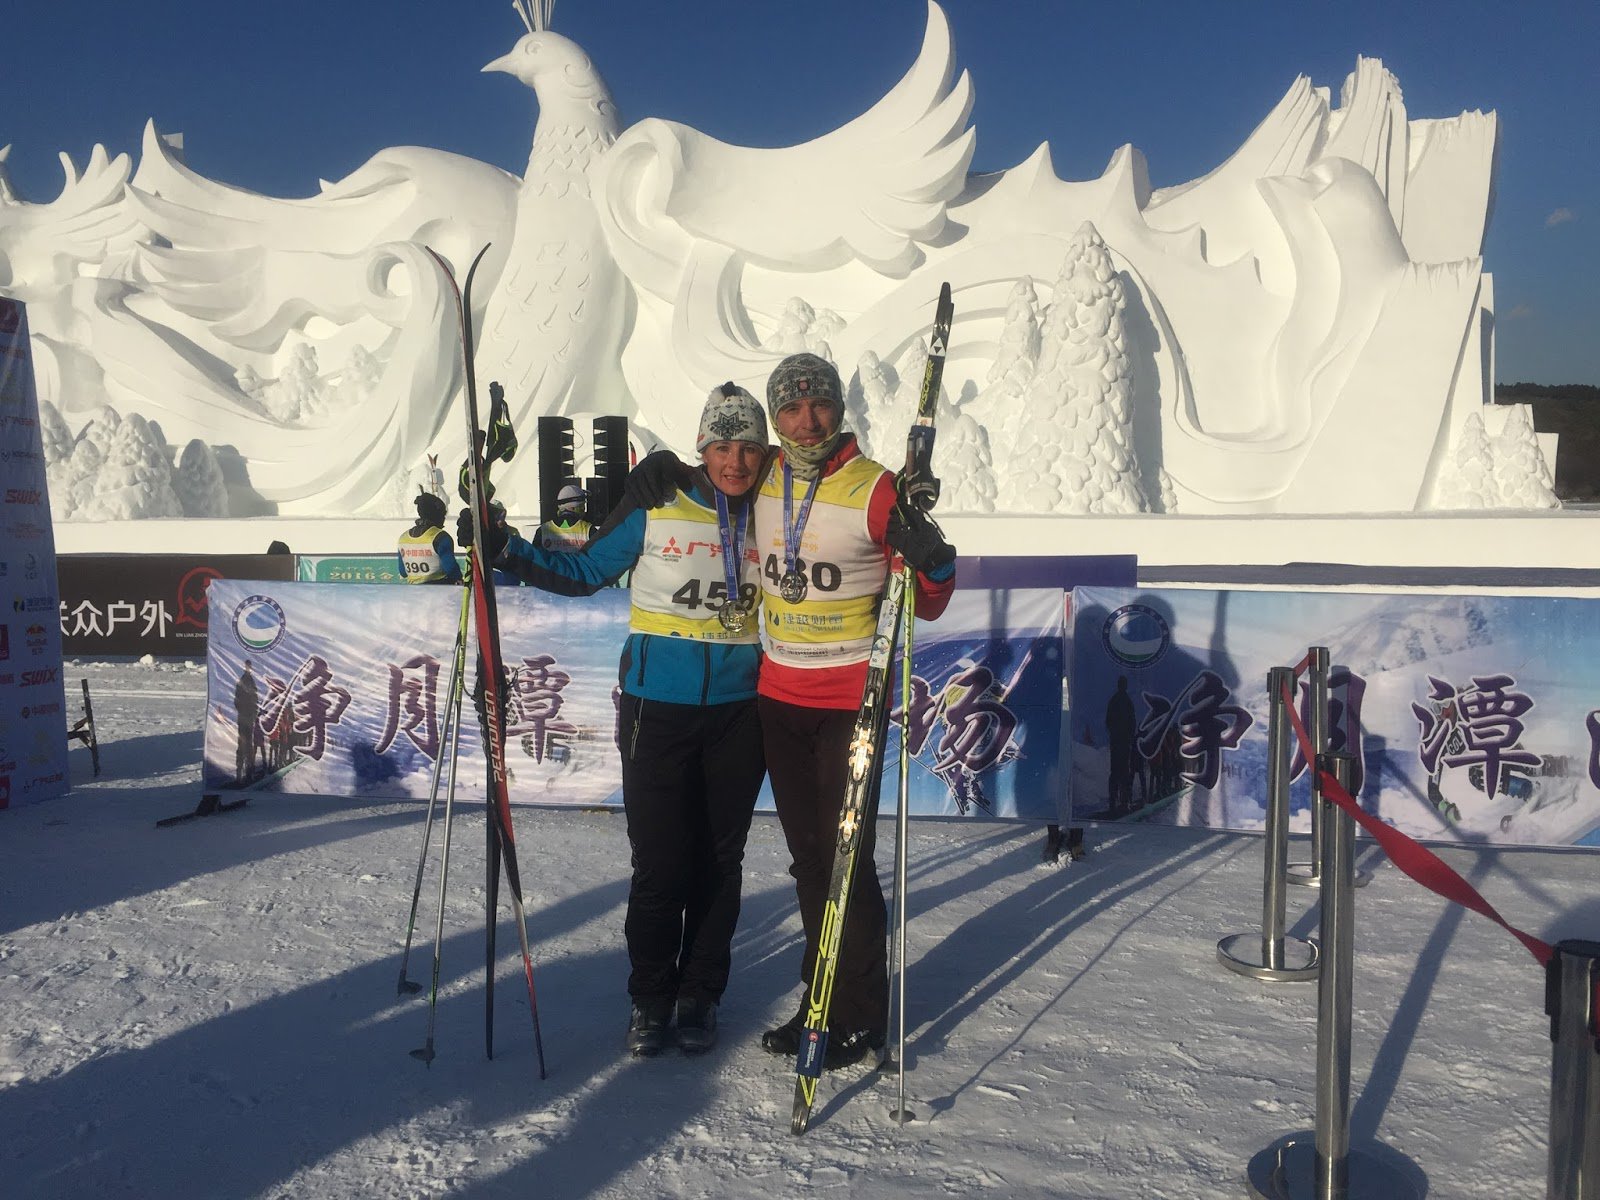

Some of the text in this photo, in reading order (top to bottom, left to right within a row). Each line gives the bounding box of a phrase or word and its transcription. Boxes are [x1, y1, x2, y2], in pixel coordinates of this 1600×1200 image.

[920, 359, 935, 413] FISCHER
[405, 562, 430, 573] 390
[484, 689, 503, 783] PELTONEN
